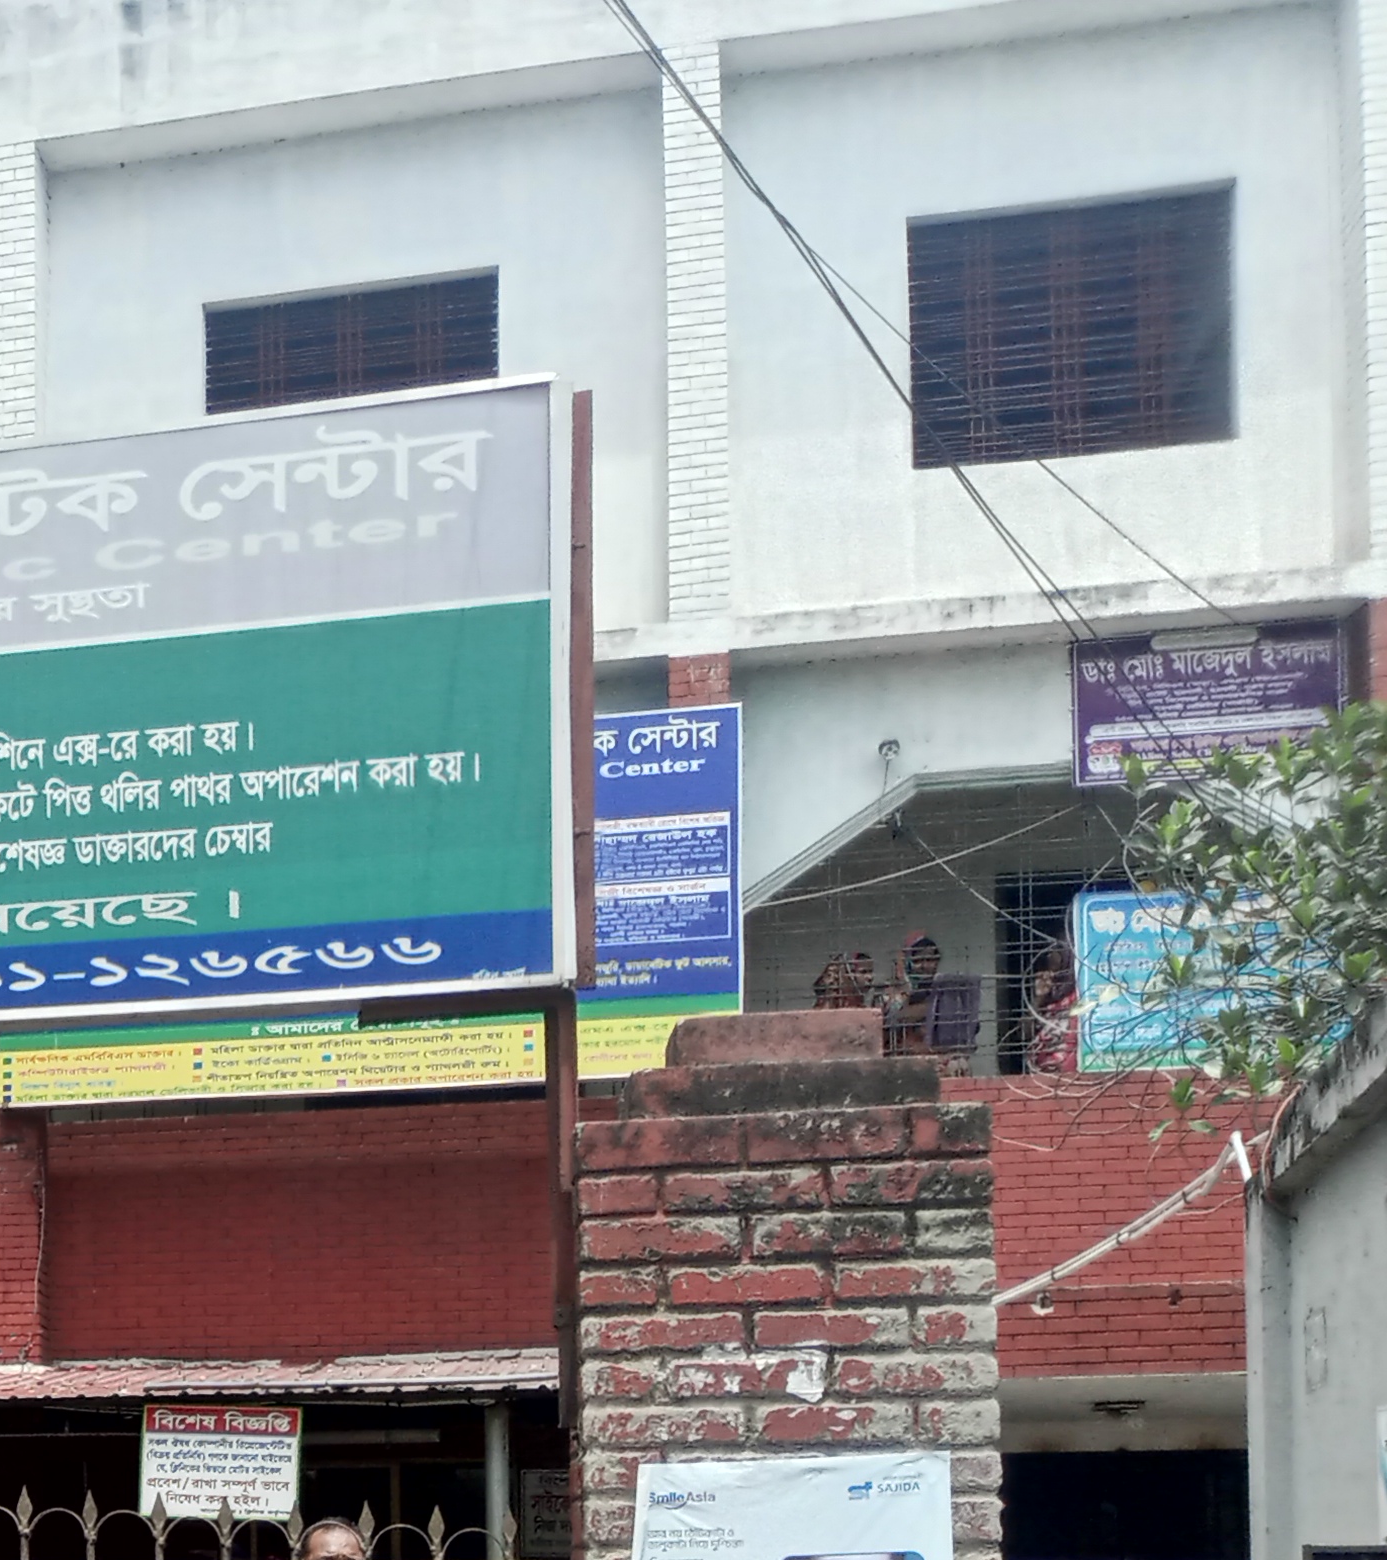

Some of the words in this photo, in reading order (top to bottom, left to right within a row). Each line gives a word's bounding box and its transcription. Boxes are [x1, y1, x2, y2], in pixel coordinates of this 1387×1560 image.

[179, 429, 494, 521] সেন্টার
[96, 512, 458, 569] Center
[1169, 645, 1252, 676] মাজেদুল
[628, 715, 721, 754] সেন্টার
[599, 758, 706, 778] Center
[153, 1409, 218, 1430] বিশেষ
[223, 1410, 292, 1432] বিজ্ঞপ্তি
[191, 1479, 217, 1491] রাখা
[261, 1480, 290, 1491] ভাবে
[877, 1482, 920, 1494] SAJIDA
